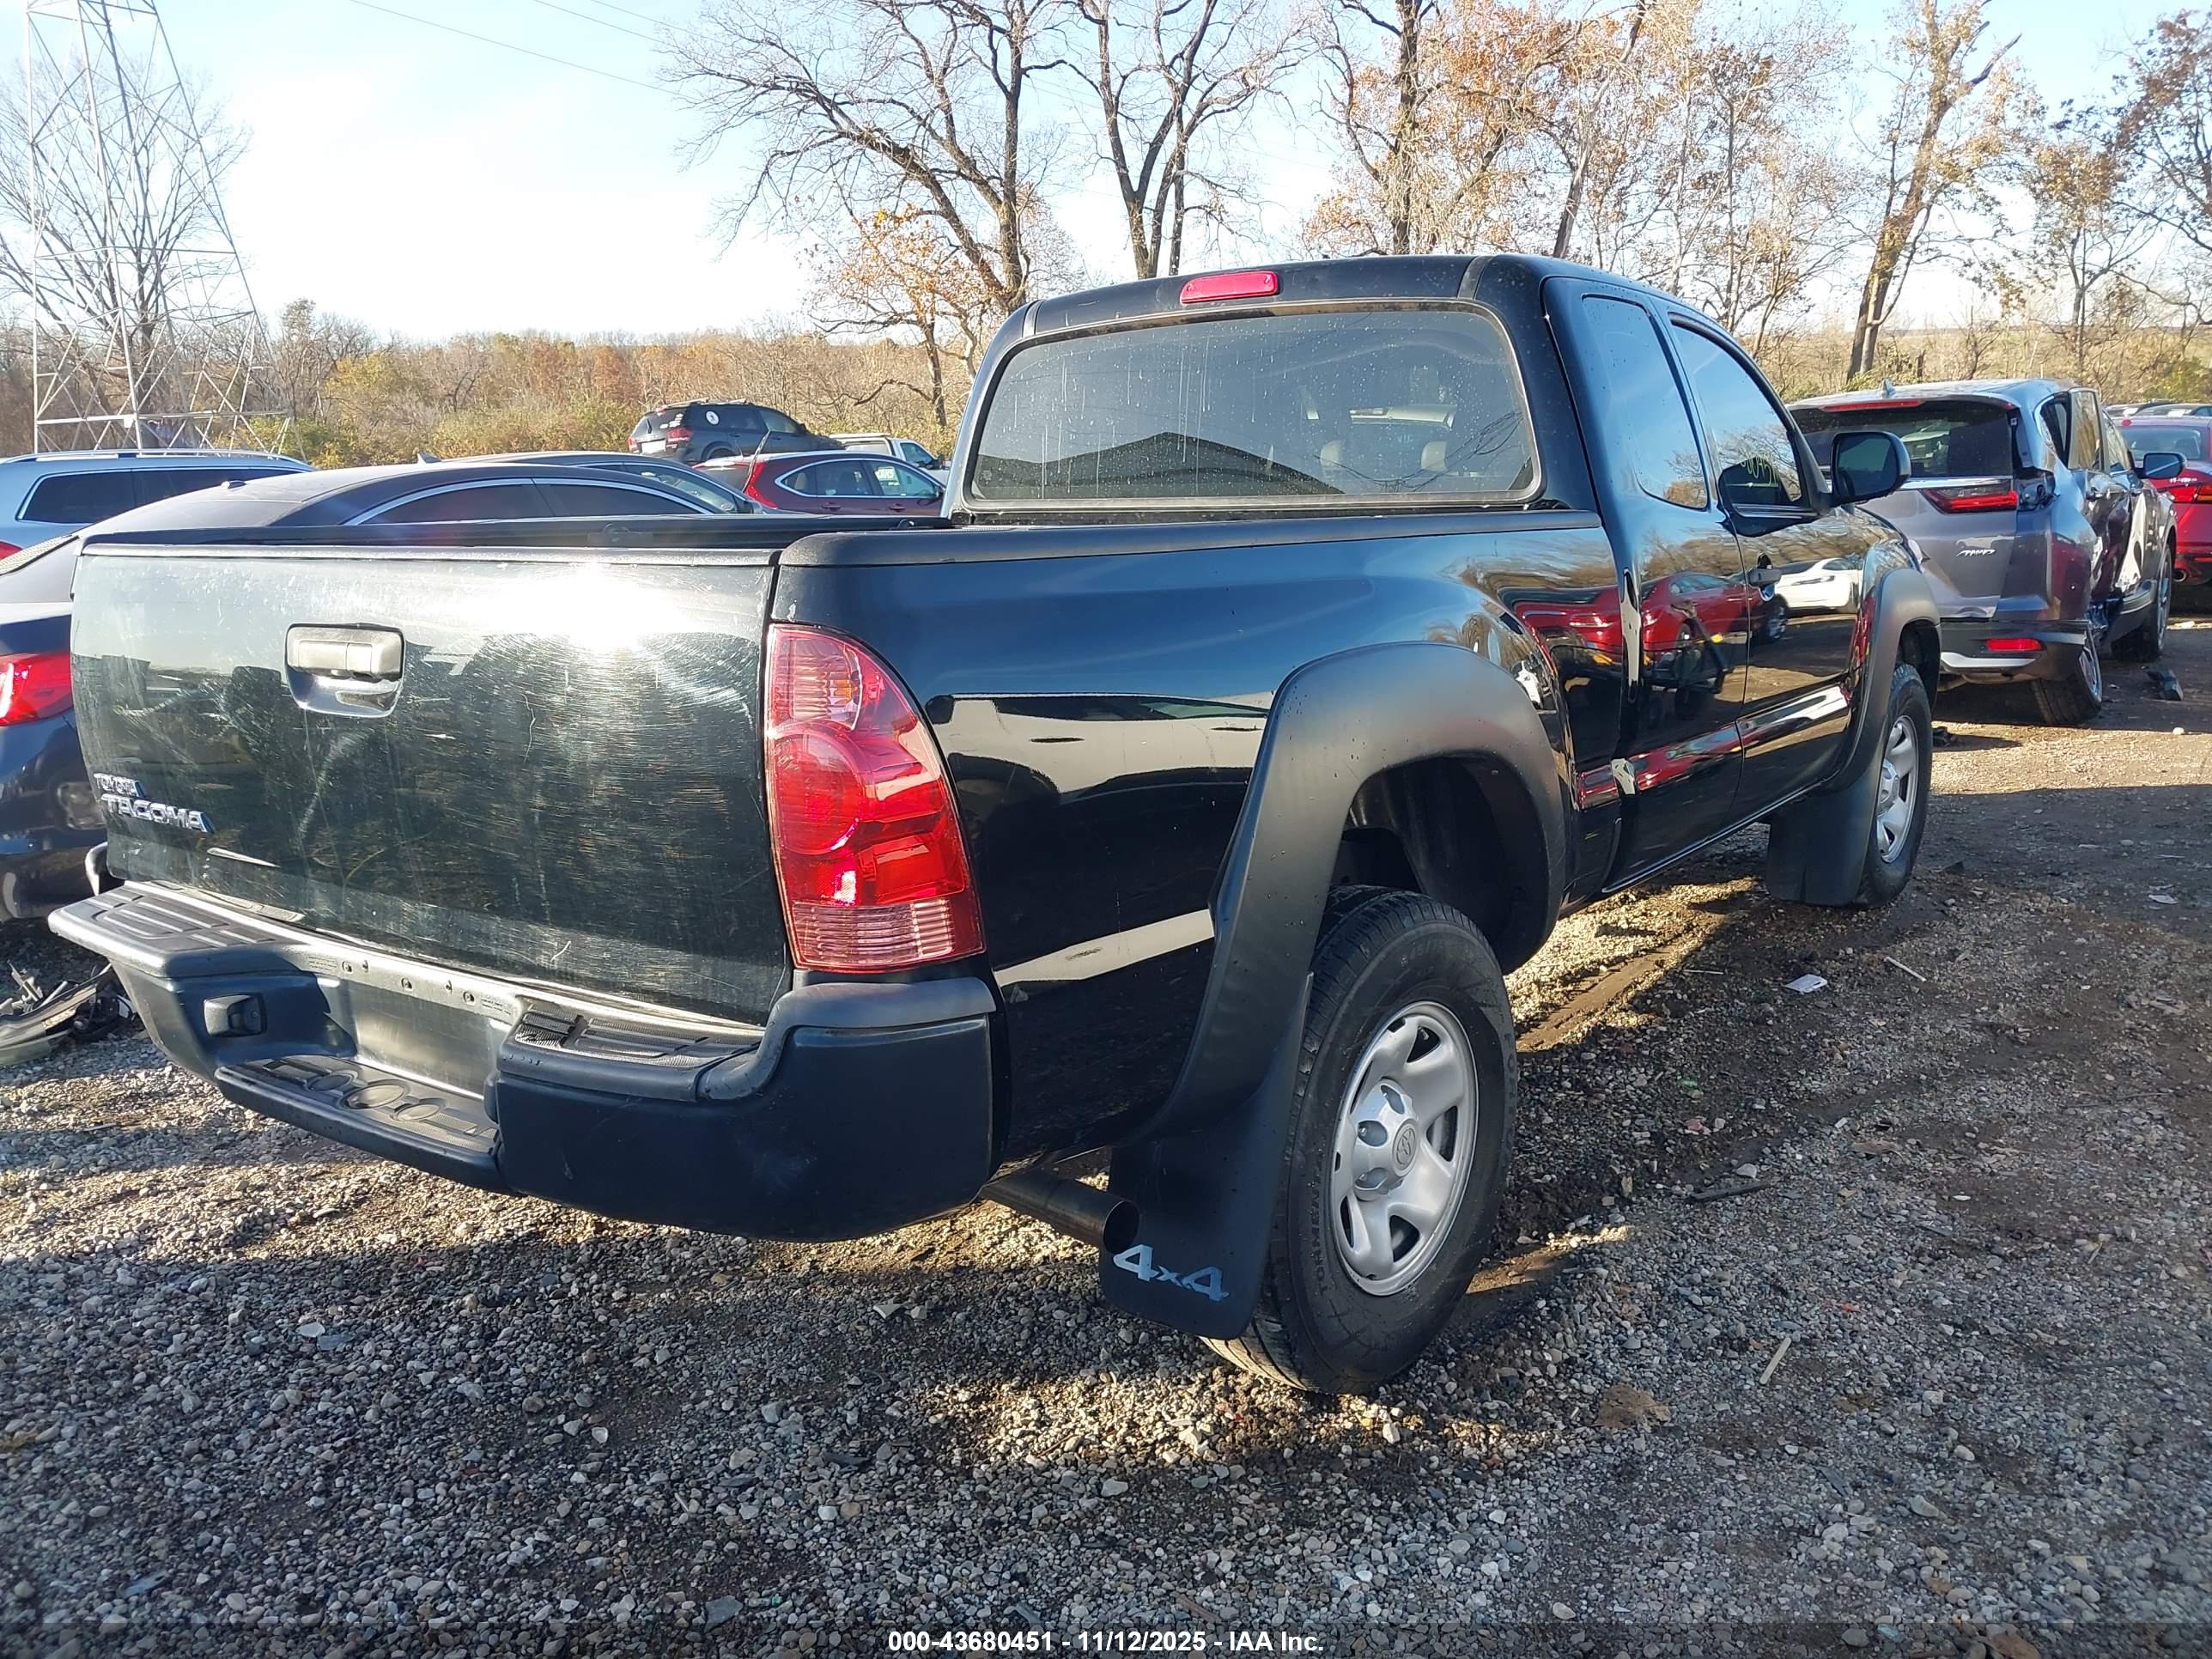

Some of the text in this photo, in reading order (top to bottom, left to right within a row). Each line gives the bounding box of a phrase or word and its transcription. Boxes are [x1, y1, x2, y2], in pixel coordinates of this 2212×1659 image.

[93, 773, 145, 798] TOYOTA
[100, 793, 214, 834] TACOMA
[1113, 1244, 1229, 1302] 4x4
